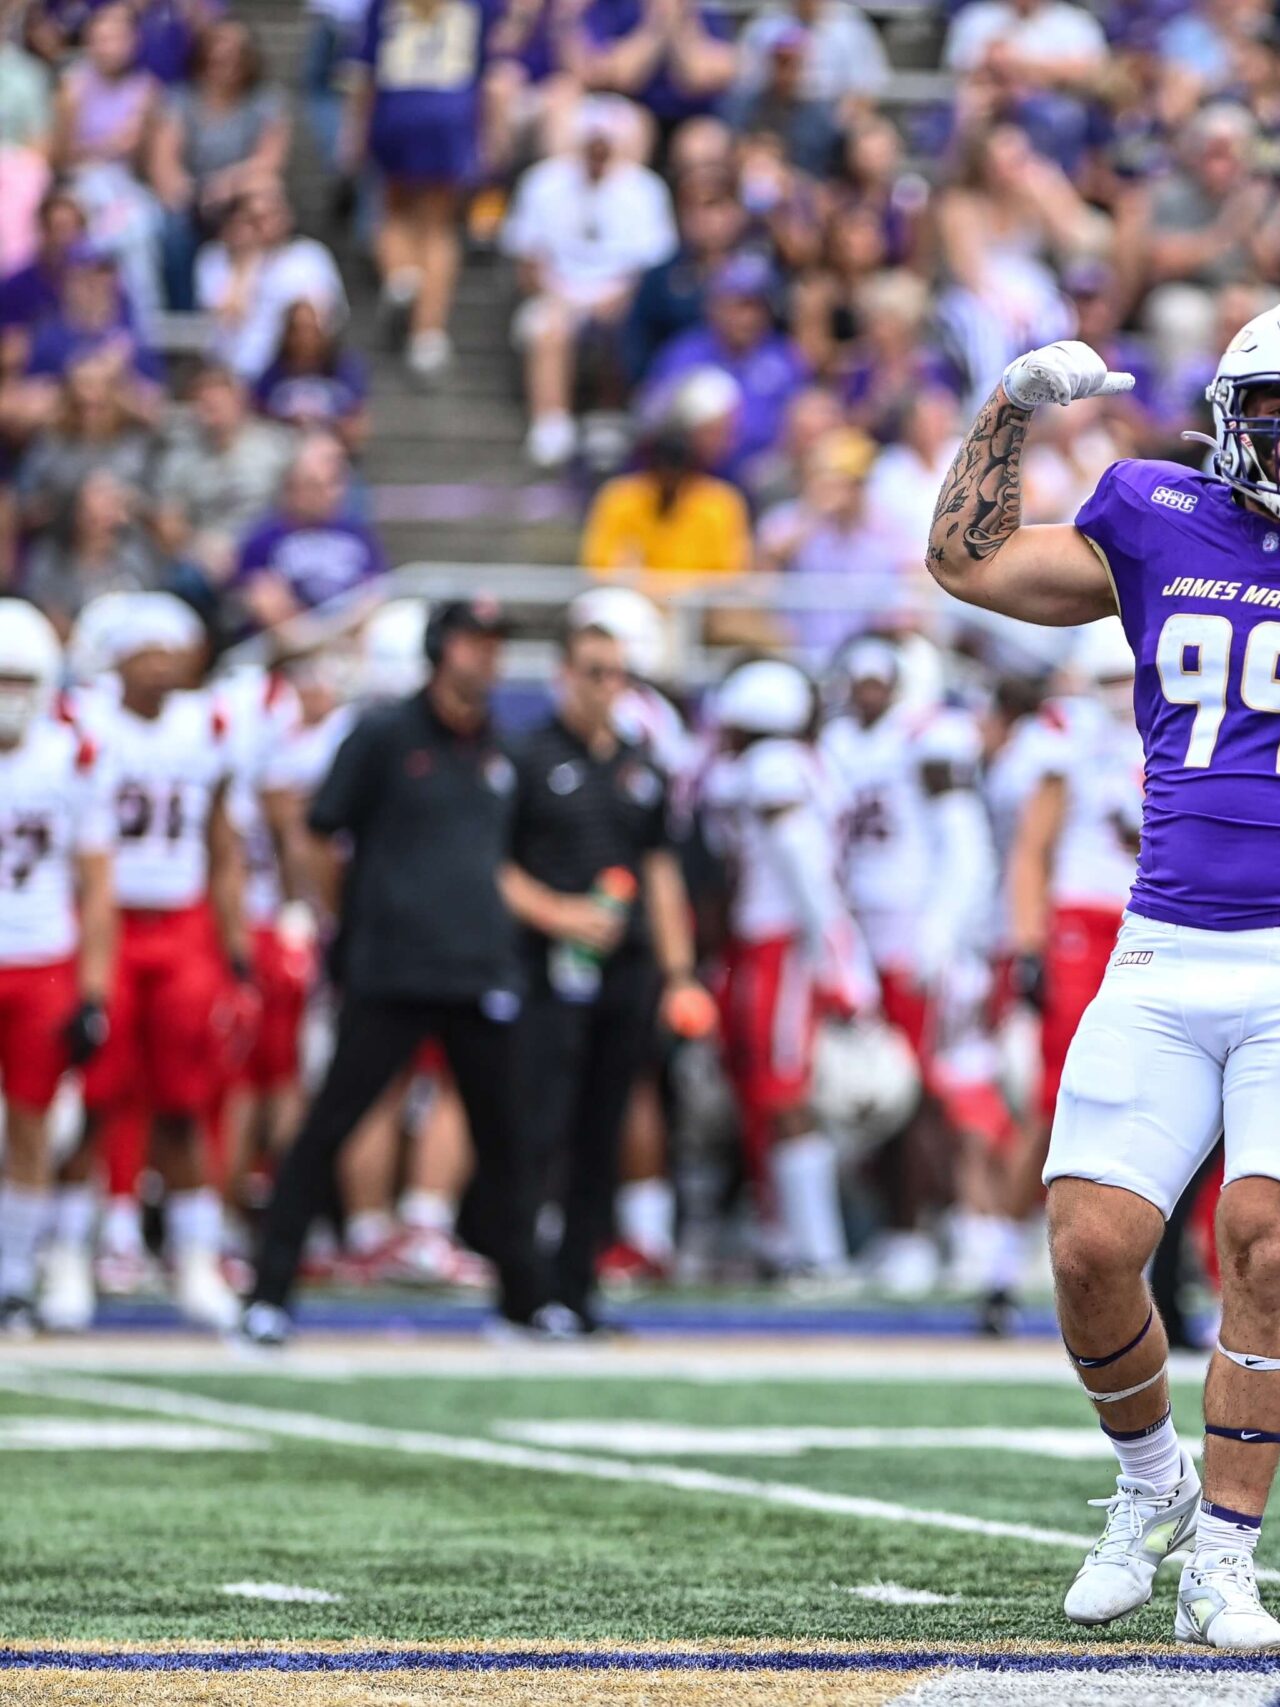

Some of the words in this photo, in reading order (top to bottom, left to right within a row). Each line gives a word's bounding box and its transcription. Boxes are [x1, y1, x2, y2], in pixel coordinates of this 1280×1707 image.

[1150, 486, 1198, 514] SBC
[1161, 576, 1242, 600] JAMES
[1114, 951, 1154, 967] JMU
